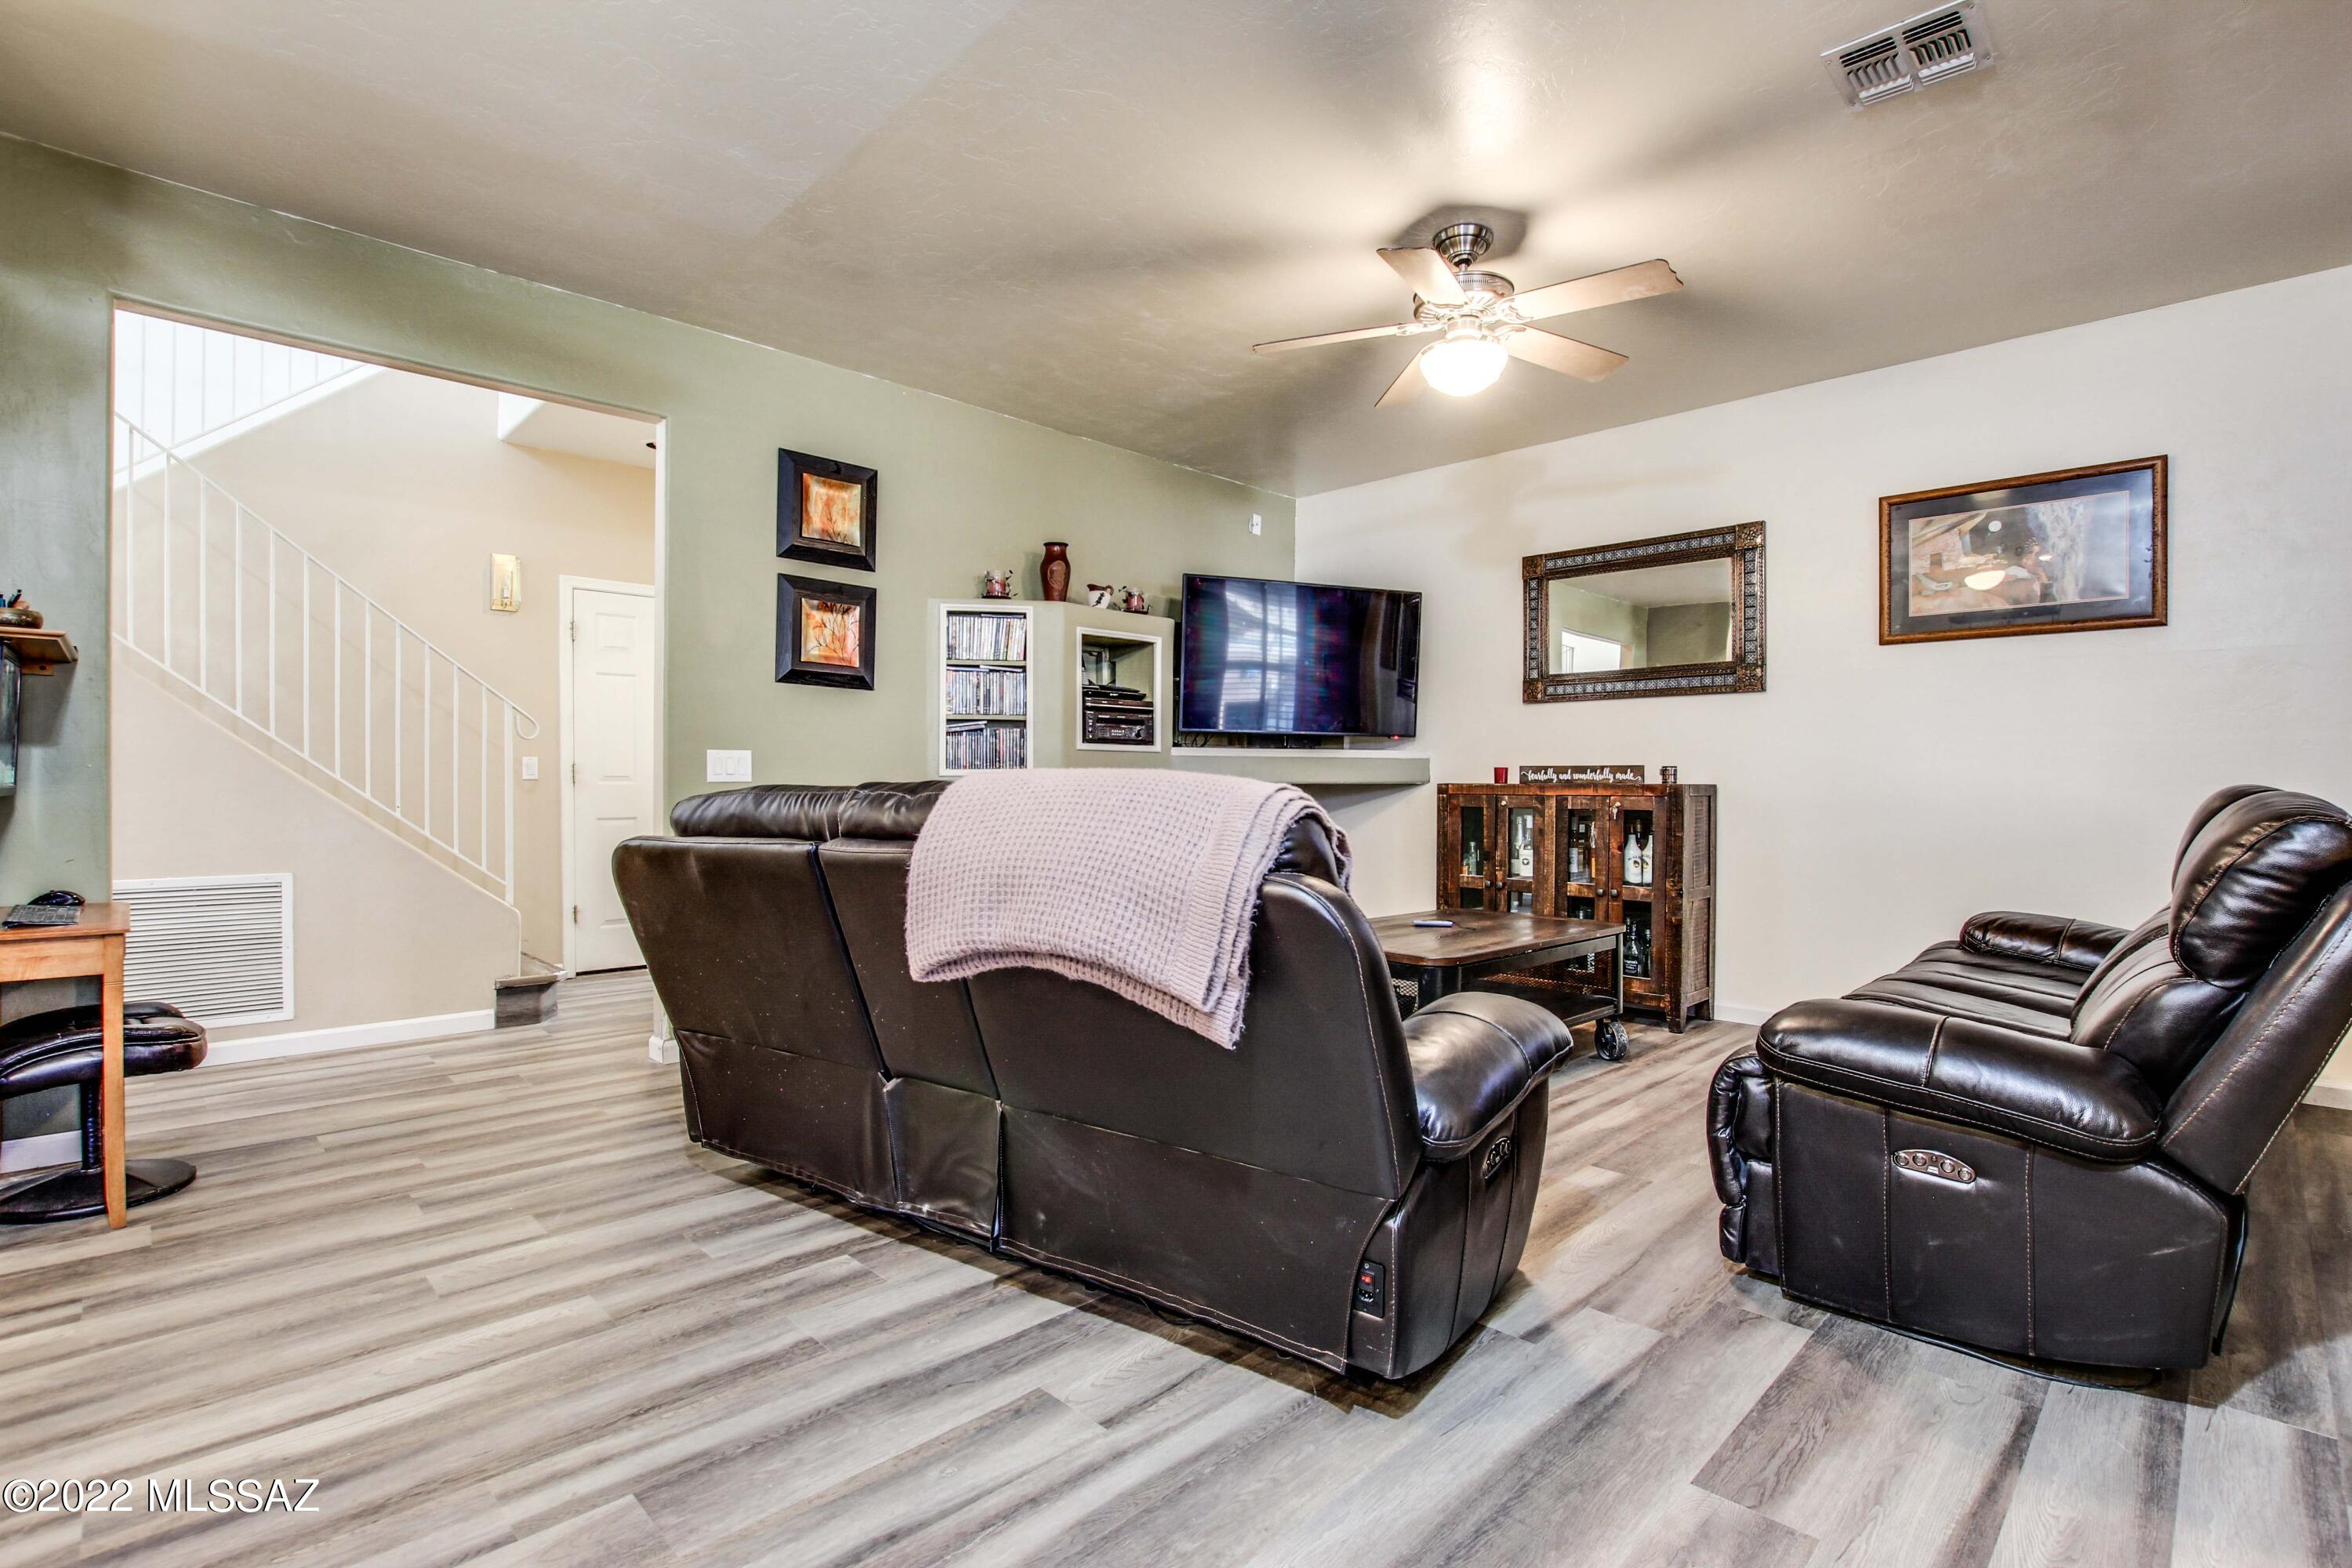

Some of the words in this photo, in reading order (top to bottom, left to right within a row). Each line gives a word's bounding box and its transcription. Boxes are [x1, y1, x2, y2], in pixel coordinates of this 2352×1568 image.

[1521, 768, 1557, 783] fearfully
[1559, 768, 1572, 780] and
[1573, 767, 1613, 783] wonderfully
[1615, 768, 1641, 781] made
